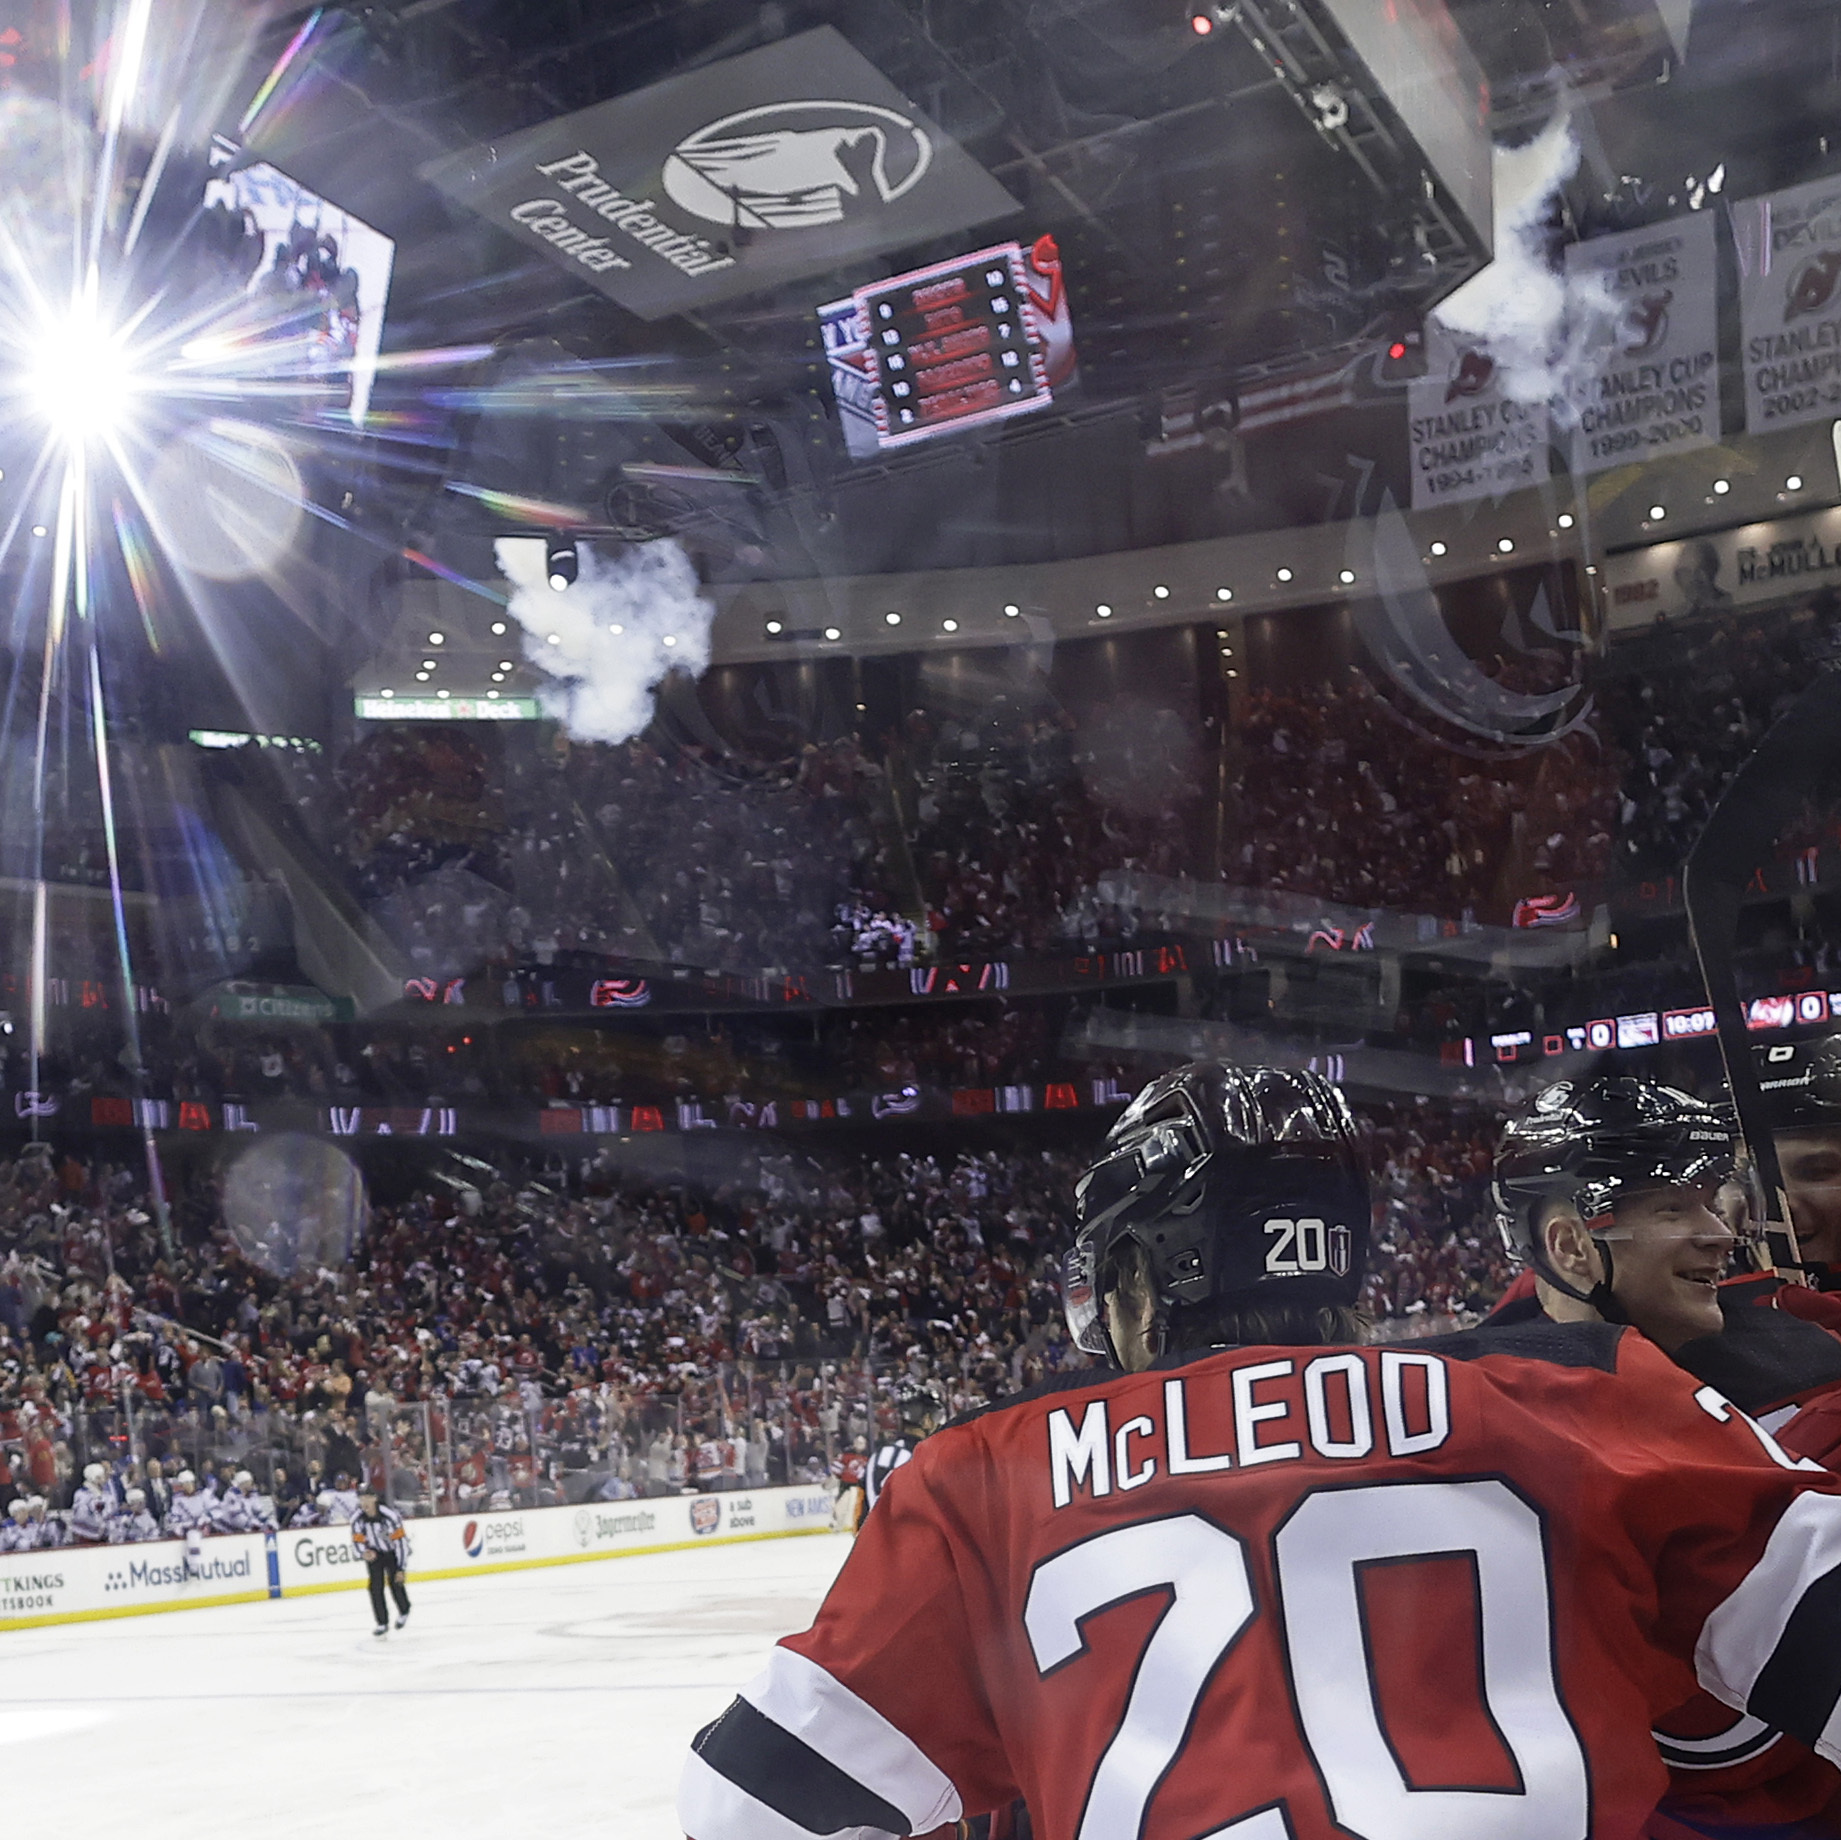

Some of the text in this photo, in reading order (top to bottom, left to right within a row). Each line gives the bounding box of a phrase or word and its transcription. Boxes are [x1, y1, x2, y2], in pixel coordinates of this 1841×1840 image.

[535, 150, 736, 277] Prudential
[510, 199, 632, 272] Center
[1750, 320, 1841, 364] STANLEY
[1670, 351, 1714, 385] CUP
[1413, 403, 1497, 444] STANLEY
[1583, 382, 1706, 434] CHAMPIONS
[1665, 1012, 1716, 1034] 10:07
[1802, 995, 1821, 1018] 0
[1591, 1024, 1613, 1047] 0
[1689, 1130, 1730, 1142] BAUER
[1263, 1218, 1327, 1273] 20
[1048, 1351, 1453, 1510] McLEOD
[485, 1517, 525, 1544] pepsi
[730, 1515, 756, 1529] above
[129, 1549, 251, 1589] MassMutual
